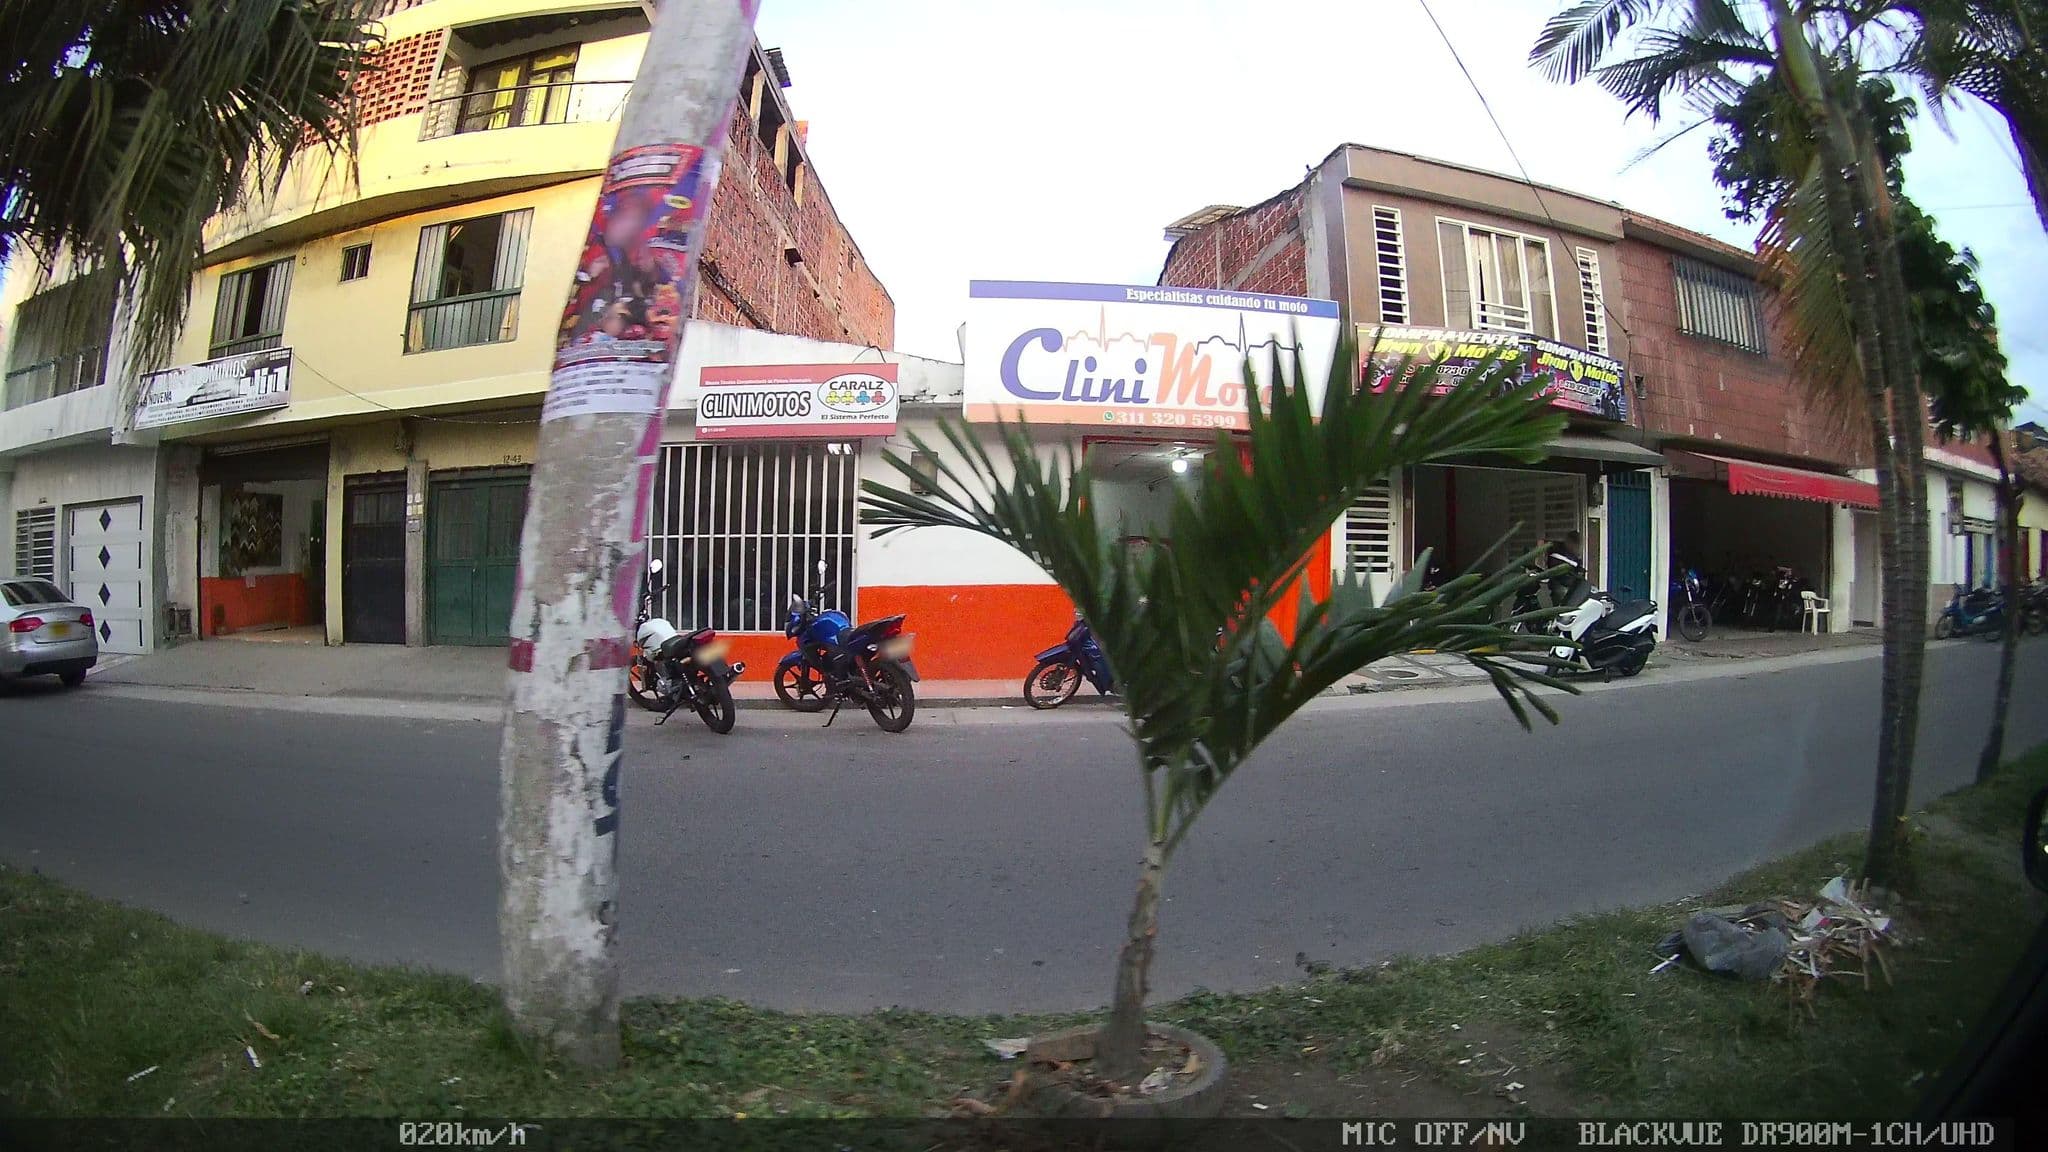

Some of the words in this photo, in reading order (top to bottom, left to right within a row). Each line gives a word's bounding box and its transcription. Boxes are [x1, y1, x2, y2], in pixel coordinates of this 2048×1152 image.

[1126, 288, 1203, 304] Especialistas
[1206, 293, 1261, 308] cuidando
[1263, 298, 1276, 311] tu
[1279, 301, 1308, 313] moto
[1368, 326, 1520, 346] COMPRAVENTA
[1536, 339, 1618, 371] COMPRAVENTA
[1536, 352, 1569, 371] Jhon
[1584, 365, 1618, 385] Motos
[829, 381, 884, 390] CARALZ
[701, 391, 811, 418] CLINIMOTOS
[1117, 413, 1146, 425] 311
[1152, 414, 1185, 427] 320
[1192, 415, 1237, 428] 5399
